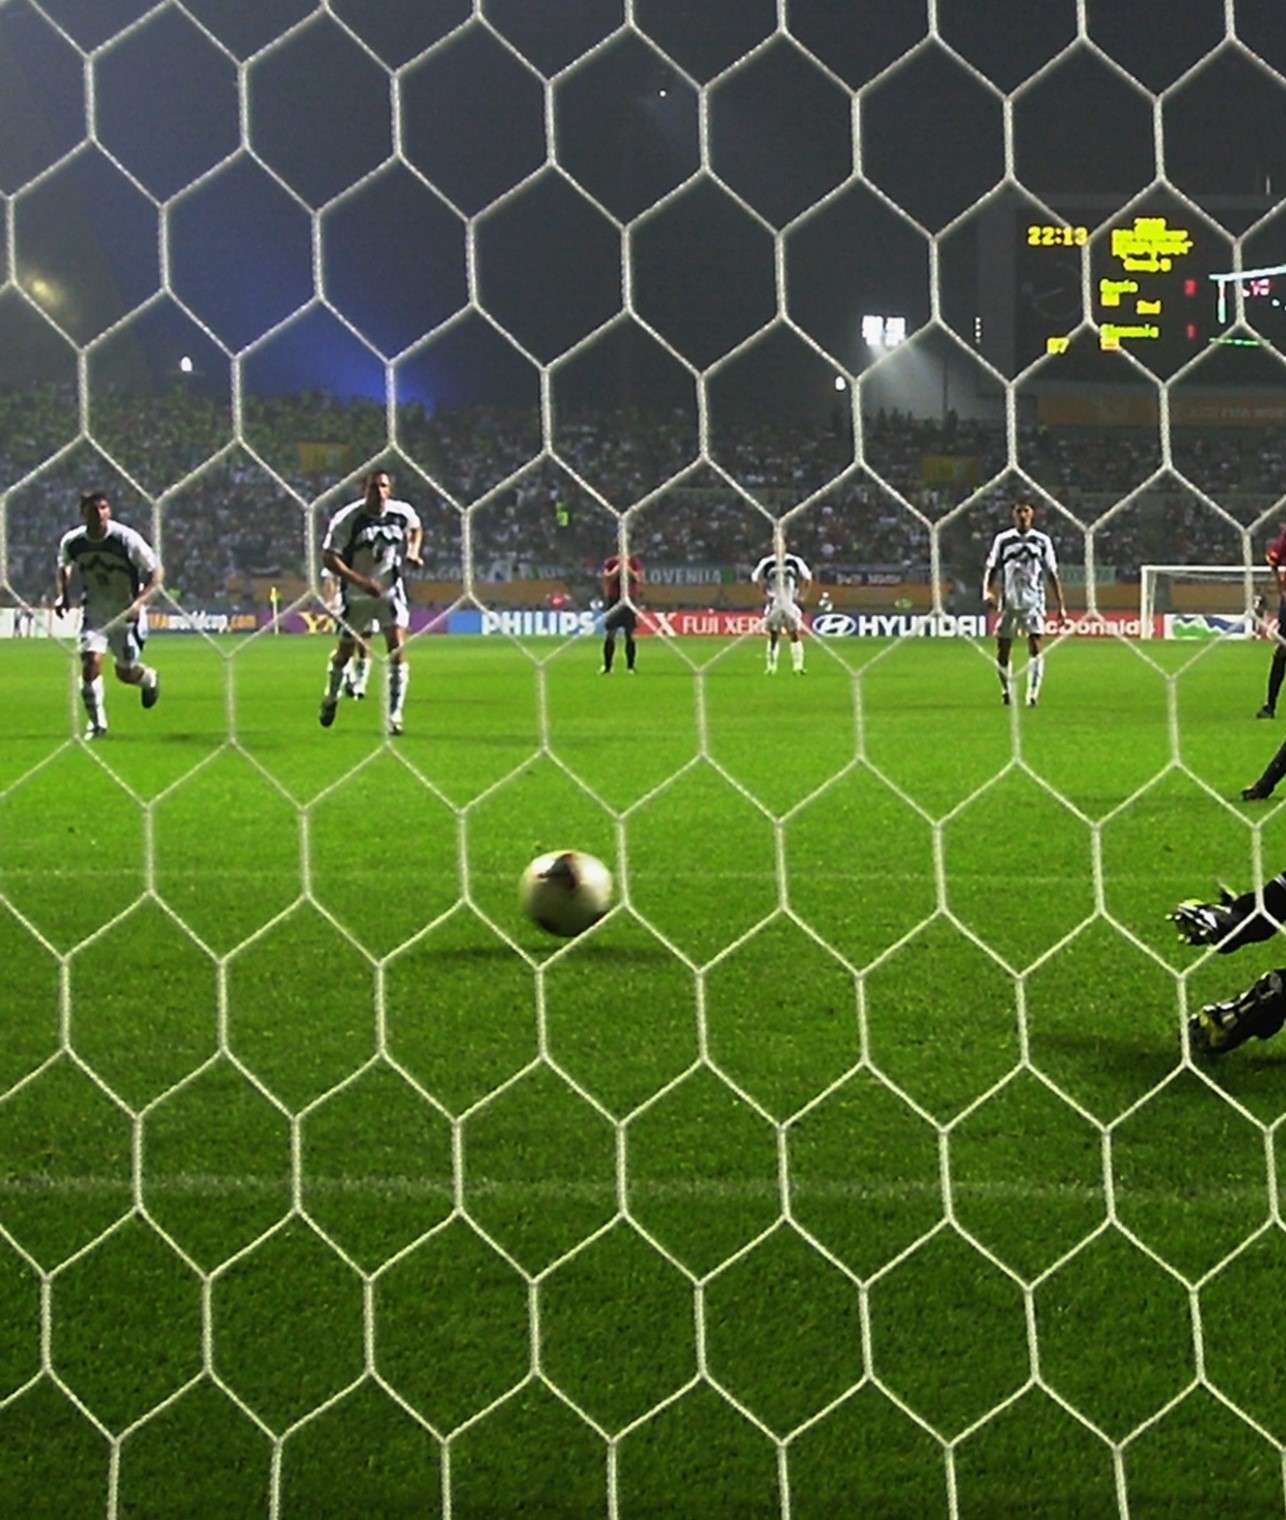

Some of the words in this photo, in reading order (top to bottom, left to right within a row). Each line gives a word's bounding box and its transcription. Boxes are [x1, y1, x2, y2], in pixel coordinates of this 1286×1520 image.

[1028, 226, 1088, 246] 22:13
[641, 567, 722, 585] LOVENIJA
[481, 610, 596, 636] PHILIPS
[682, 616, 719, 635] FUJI
[724, 616, 769, 635] XER
[858, 615, 987, 637] HYUNDAI
[1045, 619, 1155, 635] cDonald
